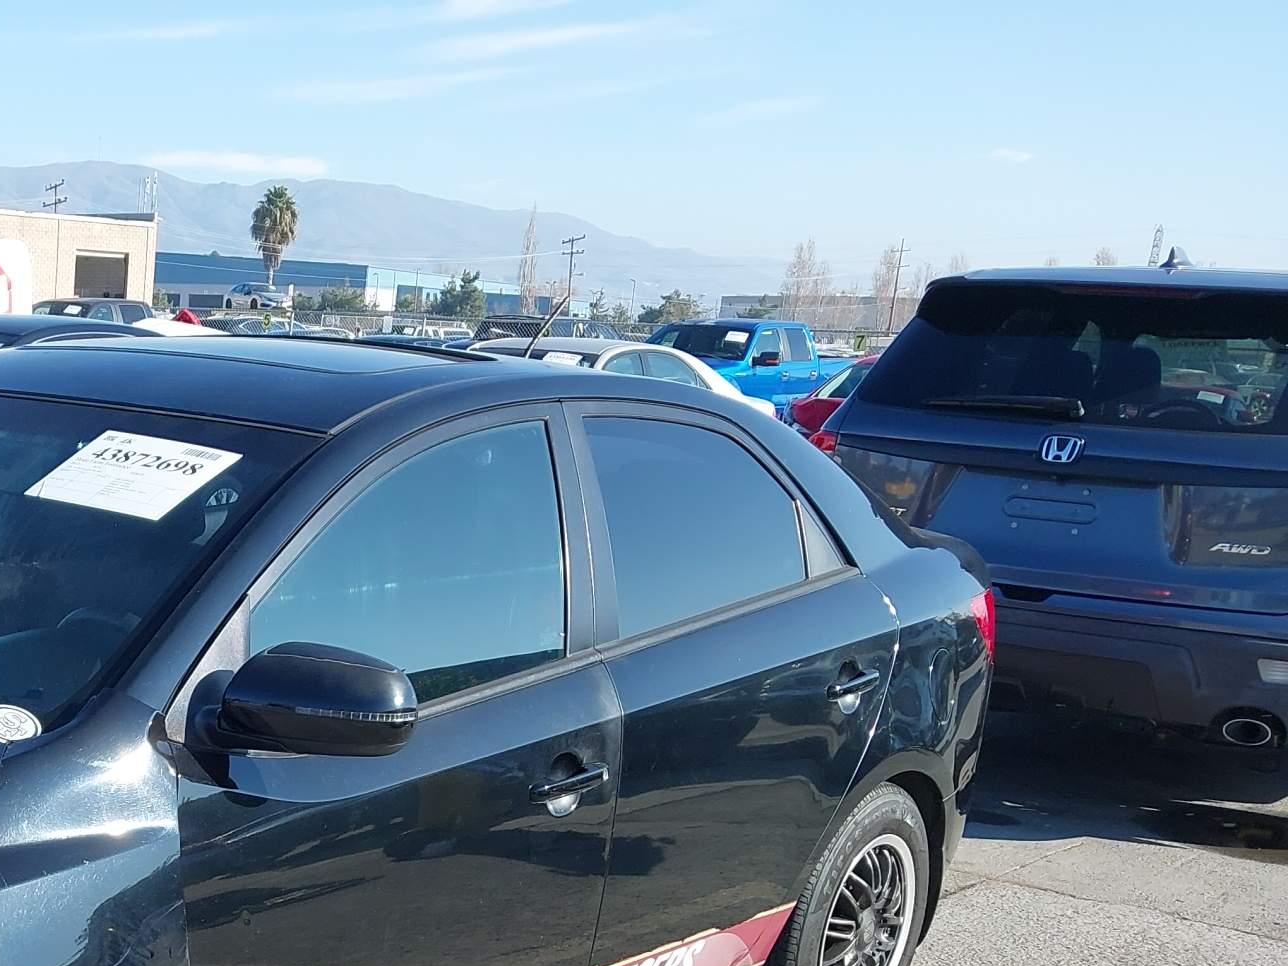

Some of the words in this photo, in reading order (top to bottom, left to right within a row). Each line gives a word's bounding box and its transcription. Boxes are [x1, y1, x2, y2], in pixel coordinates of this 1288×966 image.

[856, 335, 866, 350] 7
[91, 447, 204, 476] 43872698
[1208, 543, 1272, 555] AWD
